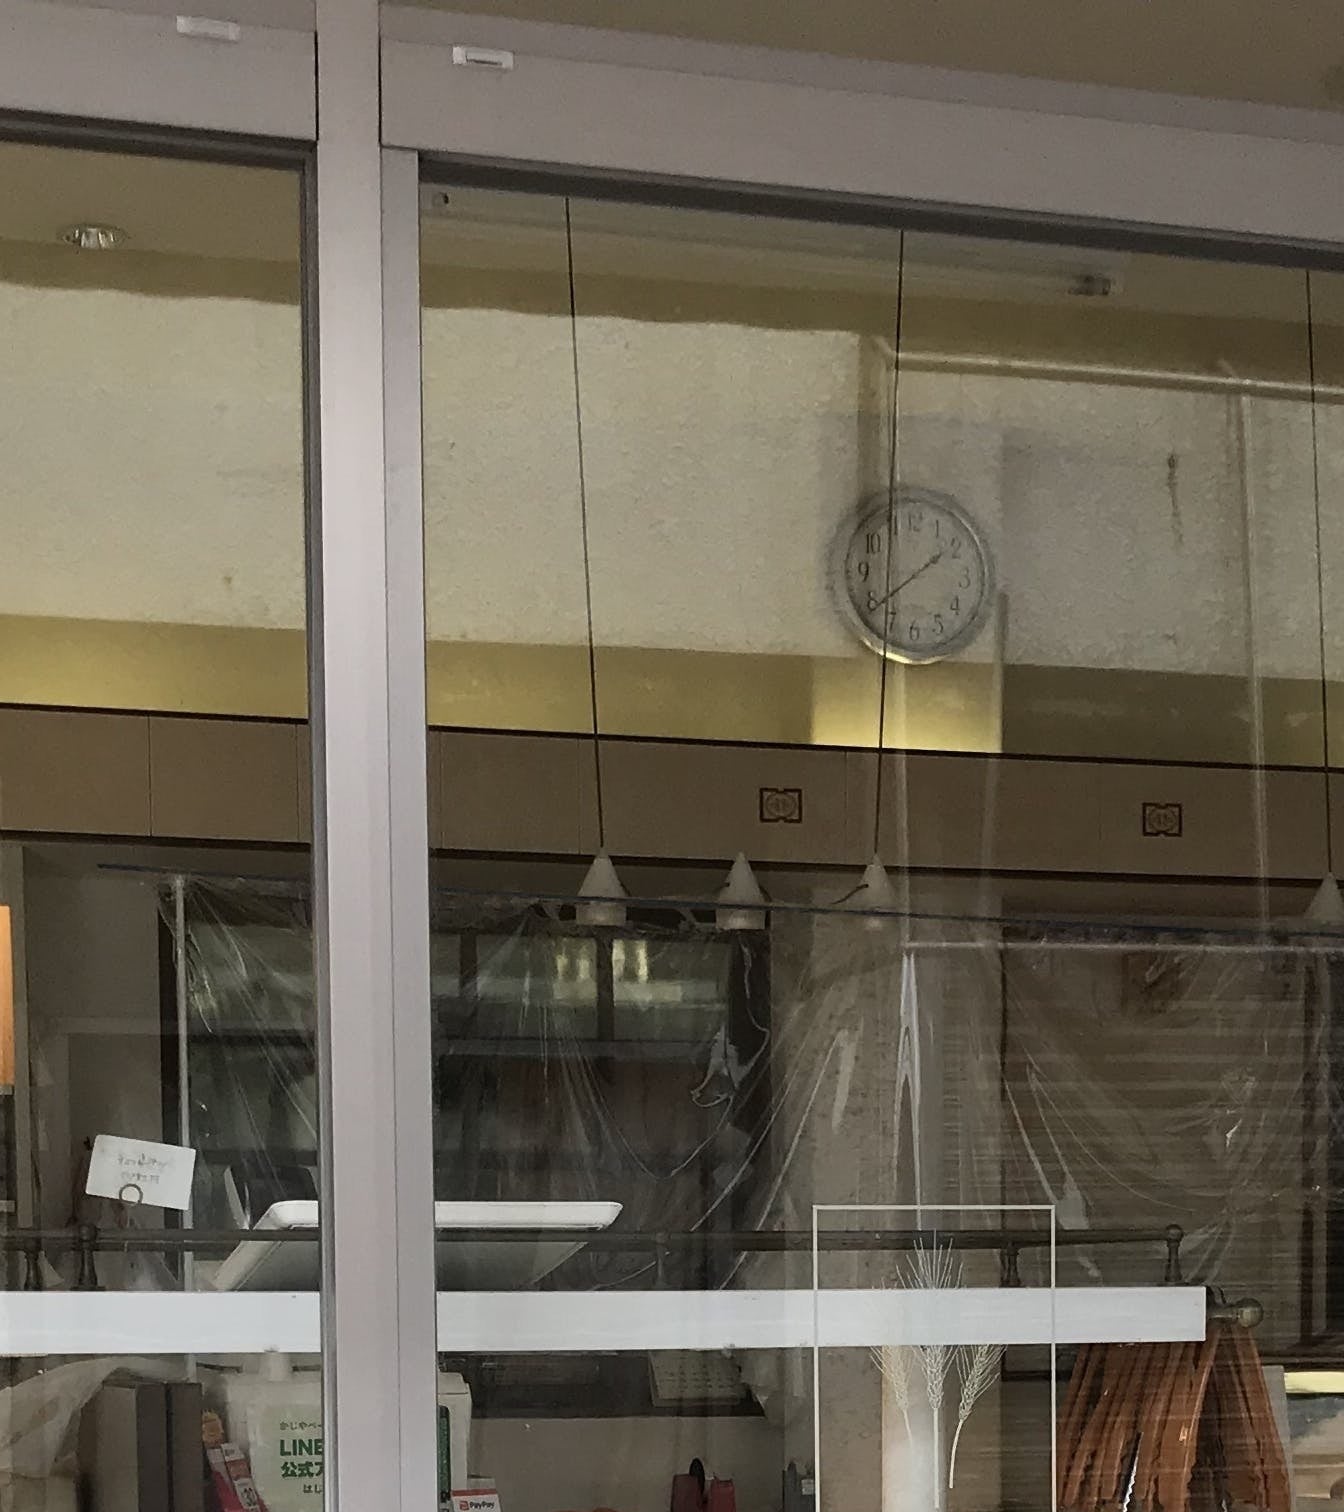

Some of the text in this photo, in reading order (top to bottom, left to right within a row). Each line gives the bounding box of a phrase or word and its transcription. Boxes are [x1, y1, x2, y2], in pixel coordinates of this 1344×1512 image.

[865, 533, 881, 555] 10
[857, 561, 869, 583] 9
[949, 595, 961, 616] 4
[908, 620, 921, 642] 6
[931, 613, 944, 636] 5
[280, 1438, 324, 1456] LINE
[469, 1501, 496, 1510] PayPay
